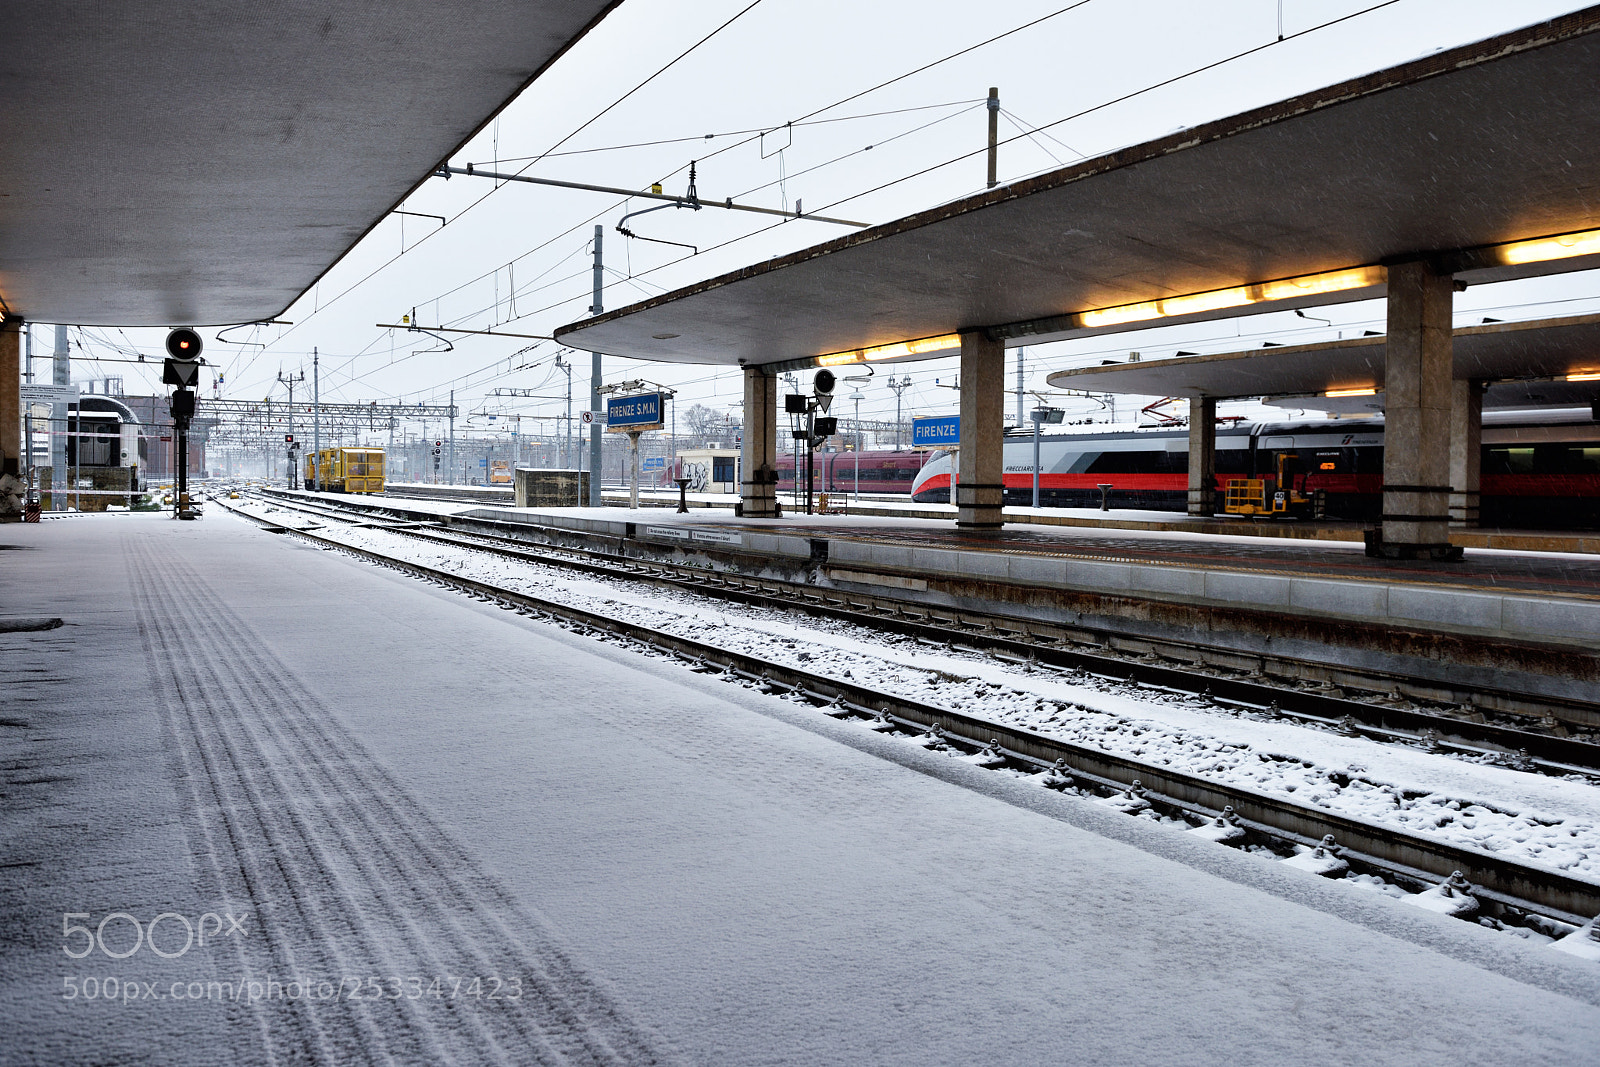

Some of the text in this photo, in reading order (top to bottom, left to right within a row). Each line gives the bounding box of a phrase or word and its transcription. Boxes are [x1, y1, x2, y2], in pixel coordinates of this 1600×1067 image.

[610, 405, 635, 418] FIRENZE
[637, 402, 657, 415] S.M.N.
[916, 425, 956, 438] FIRENZE
